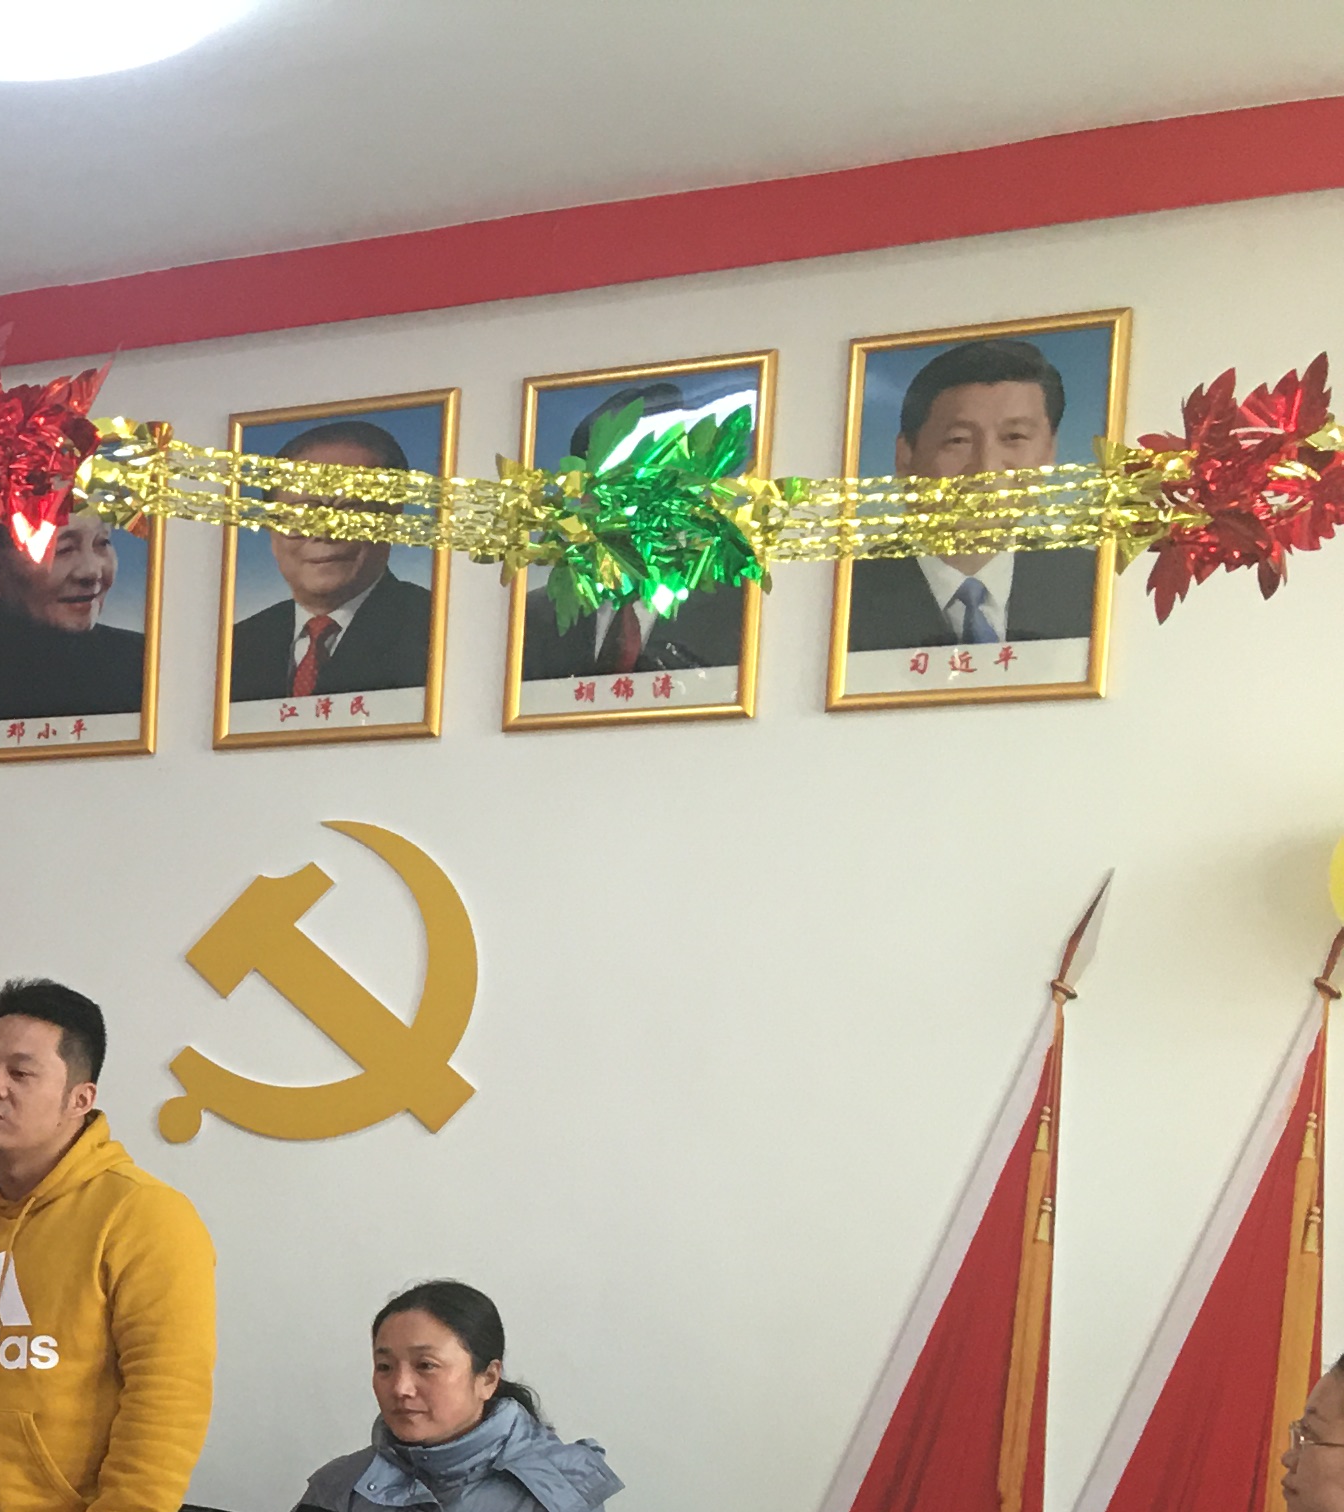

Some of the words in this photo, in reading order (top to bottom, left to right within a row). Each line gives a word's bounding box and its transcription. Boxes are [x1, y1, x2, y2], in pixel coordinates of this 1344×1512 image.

[910, 645, 1018, 674] 习近平
[574, 673, 675, 703] 胡锦涛
[279, 695, 370, 722] 江泽民
[6, 718, 87, 745] 邓小平
